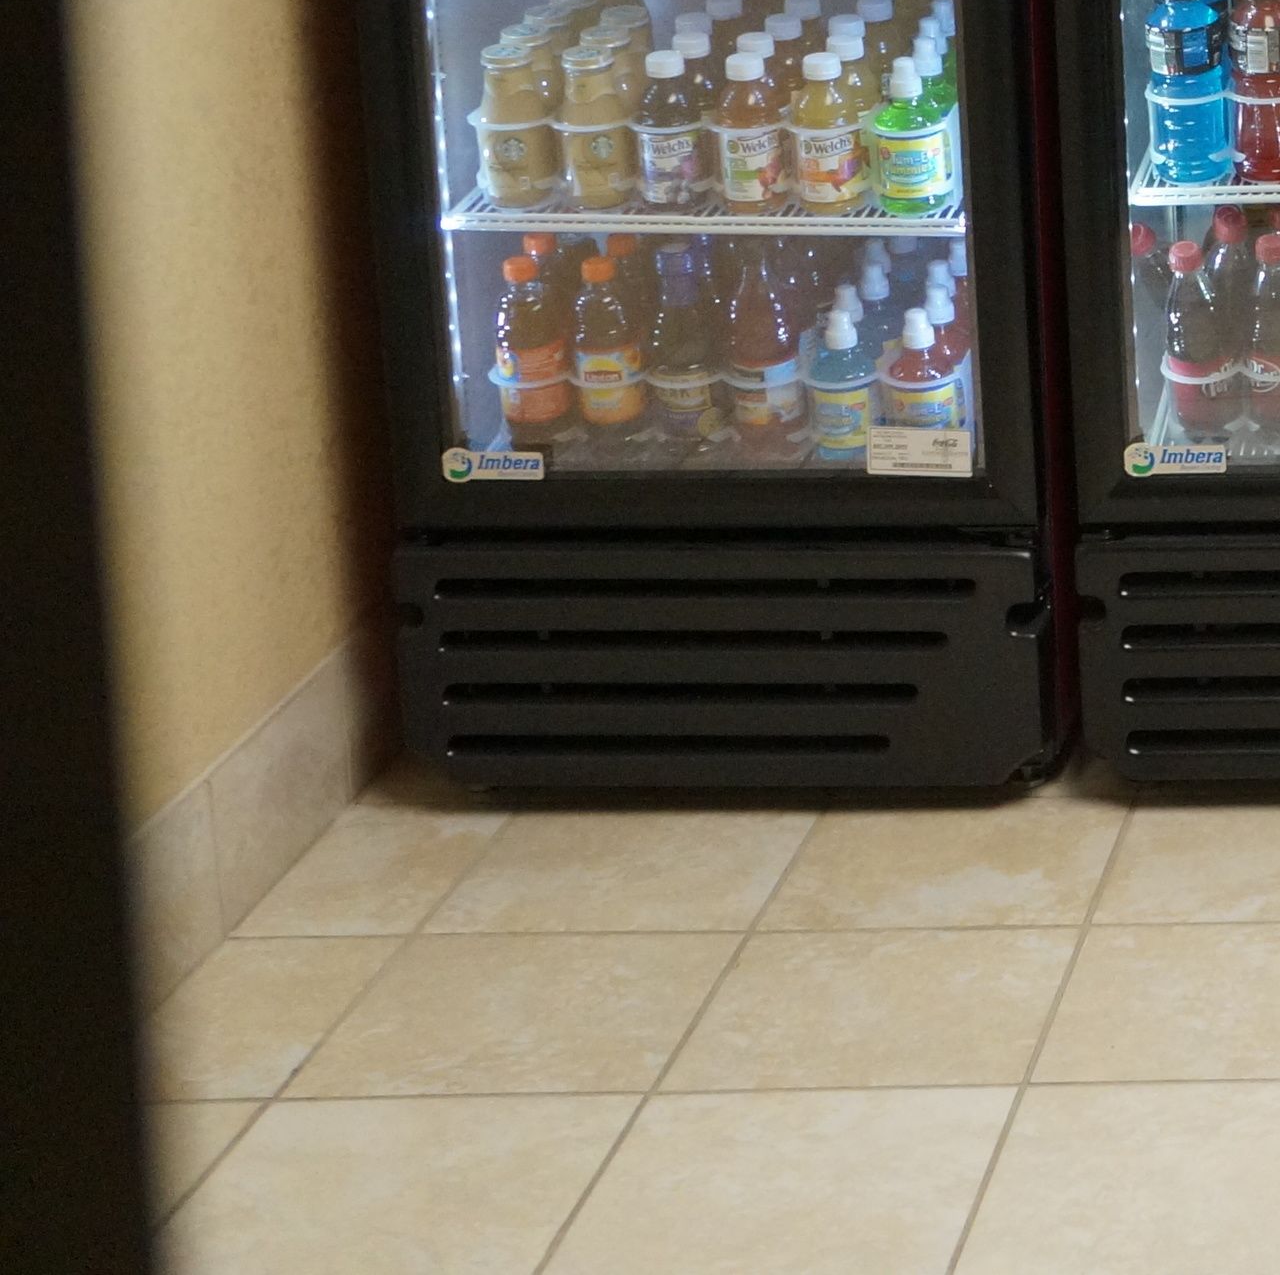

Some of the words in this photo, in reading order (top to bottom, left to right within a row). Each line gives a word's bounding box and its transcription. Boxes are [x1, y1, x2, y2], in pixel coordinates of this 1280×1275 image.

[812, 135, 853, 155] Welch's
[477, 454, 540, 470] Imbera
[1160, 448, 1223, 464] Imbera
